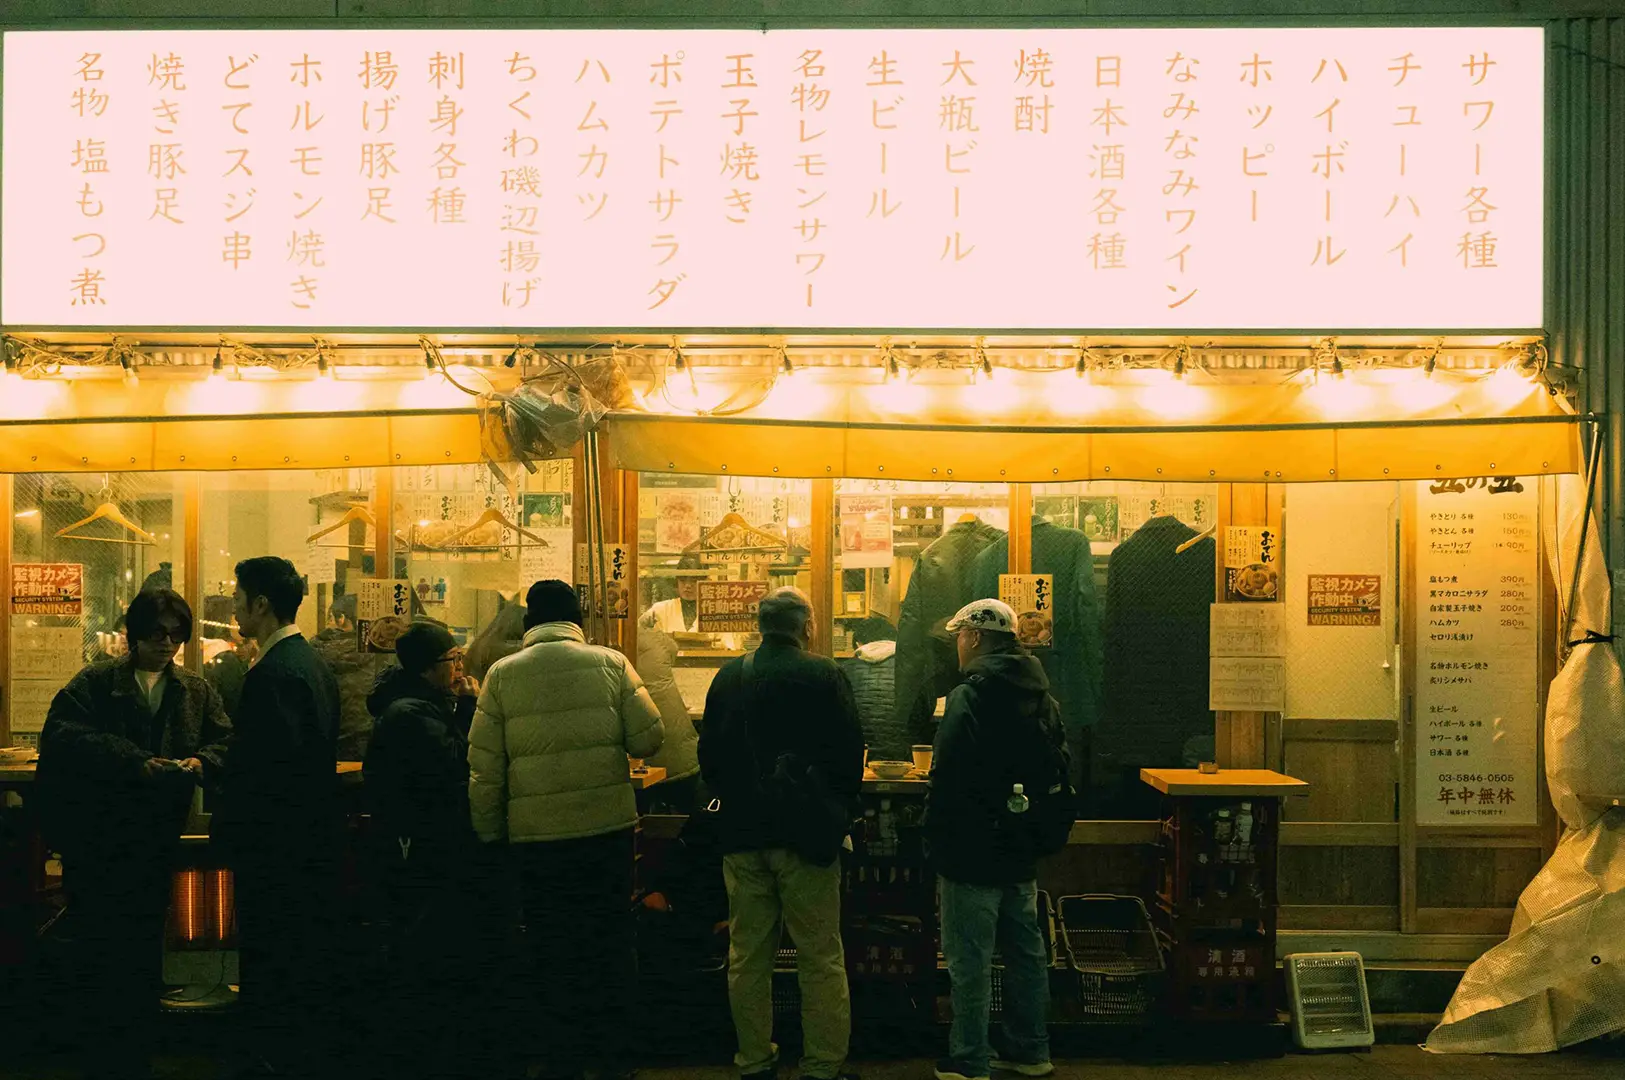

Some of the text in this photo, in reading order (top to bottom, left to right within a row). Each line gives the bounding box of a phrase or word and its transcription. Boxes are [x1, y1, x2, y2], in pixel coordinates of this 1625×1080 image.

[1013, 48, 1056, 135] 焼酎
[147, 52, 188, 225] 焼き豚足
[221, 53, 260, 271] どてスジ串
[358, 50, 401, 225] 揚げ豚足
[427, 50, 468, 225] 刺身各種
[574, 58, 613, 222] ハムカツ
[719, 52, 761, 225] 玉子焼き
[865, 49, 905, 219] 生ビール
[937, 50, 981, 263] 大瓶ビール
[1086, 54, 1130, 271] 日本酒各種
[1239, 51, 1275, 223] ホッピー
[1310, 57, 1350, 267] ハイボール
[1384, 51, 1423, 268] チューハイ
[1455, 50, 1499, 270] サワー各種
[70, 52, 110, 307] 名物 塩もつ煮
[287, 53, 326, 310] ホルモン焼き
[499, 50, 543, 309] ちくわ磯辺揚げ
[647, 50, 689, 311] ポテトサラダ
[789, 49, 832, 308] 名物レモンサワー
[1161, 50, 1201, 311] なみなみワイン
[14, 566, 80, 582] 監視カメラ
[613, 548, 627, 581] おでん
[1261, 530, 1276, 563] おでん
[1430, 541, 1472, 549] チューリップ
[14, 582, 56, 596] 作動中
[15, 603, 78, 614] WARNING!
[393, 583, 408, 616] おでん
[701, 584, 768, 599] 監視カメラ
[701, 600, 744, 614] 作動中
[1036, 578, 1050, 611] おでん
[1310, 577, 1379, 592] 監視カメラ
[1310, 592, 1354, 607] 作動中
[1430, 604, 1483, 612] 自家製玉子焼き
[1312, 614, 1377, 625] WARNING!
[1430, 662, 1489, 670] 名物ホルモン焼き
[1429, 705, 1459, 713] 生ビール
[1429, 720, 1466, 728] ハイボール
[1437, 786, 1516, 805] 年中無休
[1438, 774, 1514, 782] 03-5846-0505
[1207, 948, 1246, 963] 清酒
